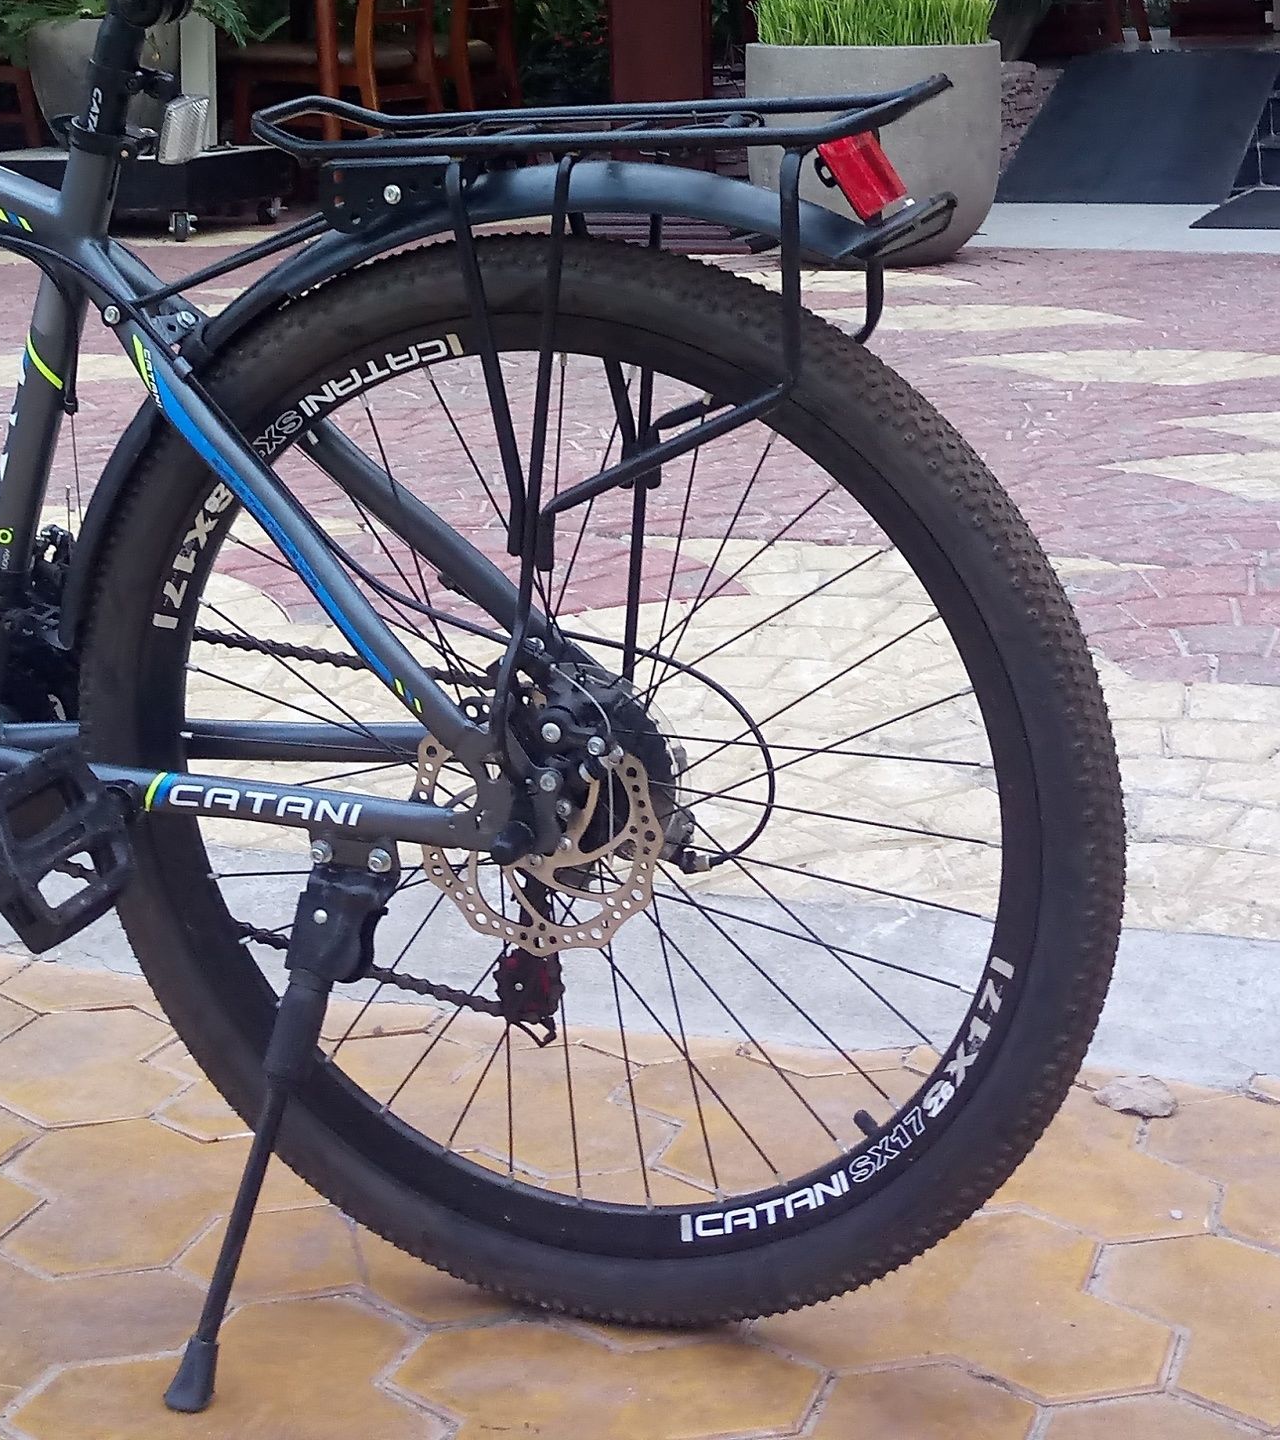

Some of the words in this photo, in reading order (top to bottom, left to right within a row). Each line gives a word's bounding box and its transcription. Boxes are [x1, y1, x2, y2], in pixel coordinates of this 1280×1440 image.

[85, 86, 104, 135] CATA
[143, 347, 166, 410] CATANI
[300, 339, 448, 418] CATANI
[257, 409, 304, 457] SX
[167, 783, 363, 827] CATANI
[694, 1170, 850, 1237] CATANI
[849, 1106, 925, 1184] SX17
